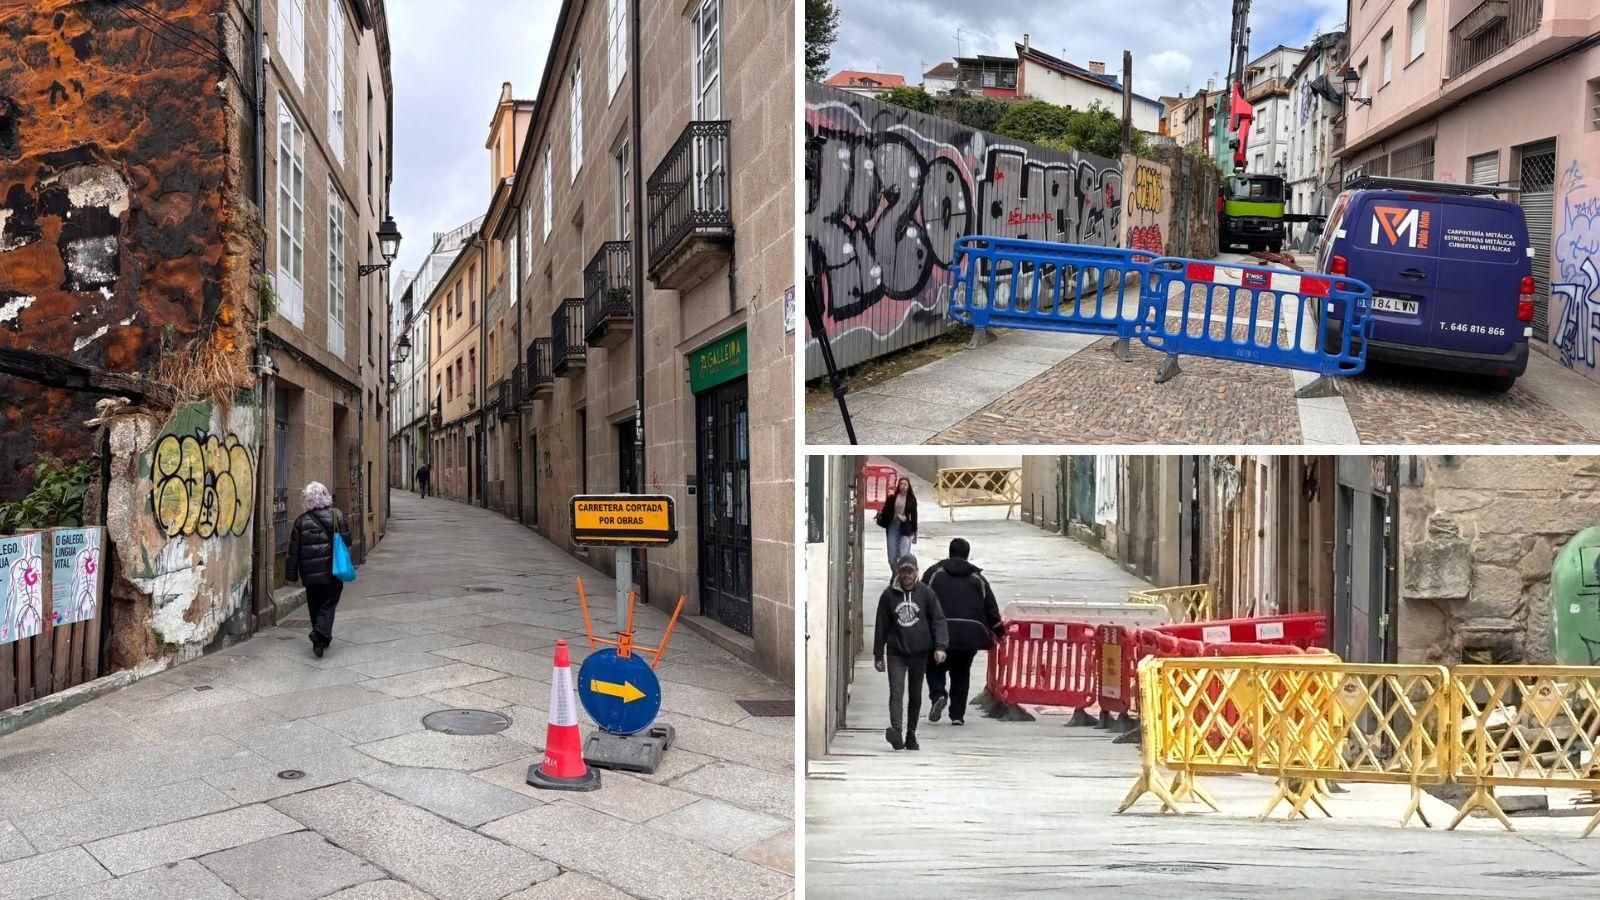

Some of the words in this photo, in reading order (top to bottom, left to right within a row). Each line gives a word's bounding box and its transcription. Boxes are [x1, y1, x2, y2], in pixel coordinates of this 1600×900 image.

[1447, 229, 1484, 237] CARPINTERÍA
[1485, 231, 1514, 239] METÁLICA
[1444, 235, 1484, 243] ESTRUCTURAS
[1484, 238, 1516, 246] METÁLICAS
[1448, 242, 1479, 250] CUBIERTAS
[1479, 244, 1511, 252] METÁLICAS
[1367, 298, 1391, 309] 184
[1394, 301, 1415, 312] LWN
[1440, 321, 1448, 330] T.
[1450, 322, 1468, 331] 646
[1470, 325, 1486, 334] 816
[1488, 327, 1505, 336] 866
[578, 503, 624, 512] CARRETERA
[625, 504, 663, 512] CORTADA
[599, 516, 615, 525] POR
[616, 516, 644, 525] OBRAS
[55, 535, 61, 546] O
[55, 546, 76, 558] LINGUA
[54, 559, 70, 568] VITAL
